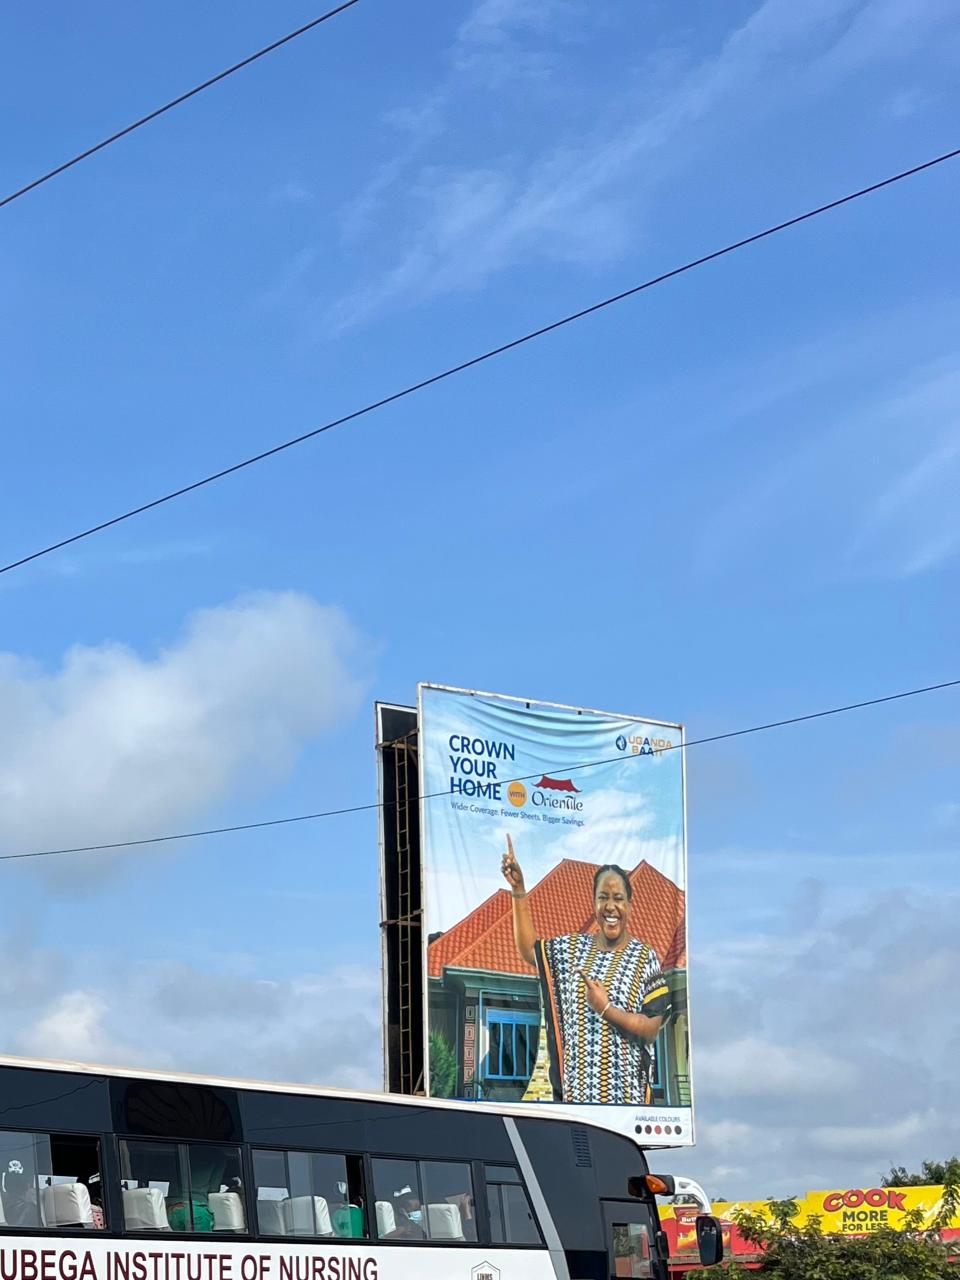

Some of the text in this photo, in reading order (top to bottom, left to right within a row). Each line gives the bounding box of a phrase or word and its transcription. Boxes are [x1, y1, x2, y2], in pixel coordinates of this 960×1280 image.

[448, 734, 515, 761] CROWN
[628, 735, 672, 749] UGANDA
[448, 754, 498, 780] YOUR
[450, 776, 502, 801] HOME
[509, 790, 526, 799] WITH
[451, 801, 468, 812] Wider
[500, 808, 519, 819] Fewer
[542, 814, 560, 825] Bigger
[822, 1188, 907, 1213] COOK
[842, 1209, 889, 1223] MORE
[842, 1222, 863, 1232] FOR
